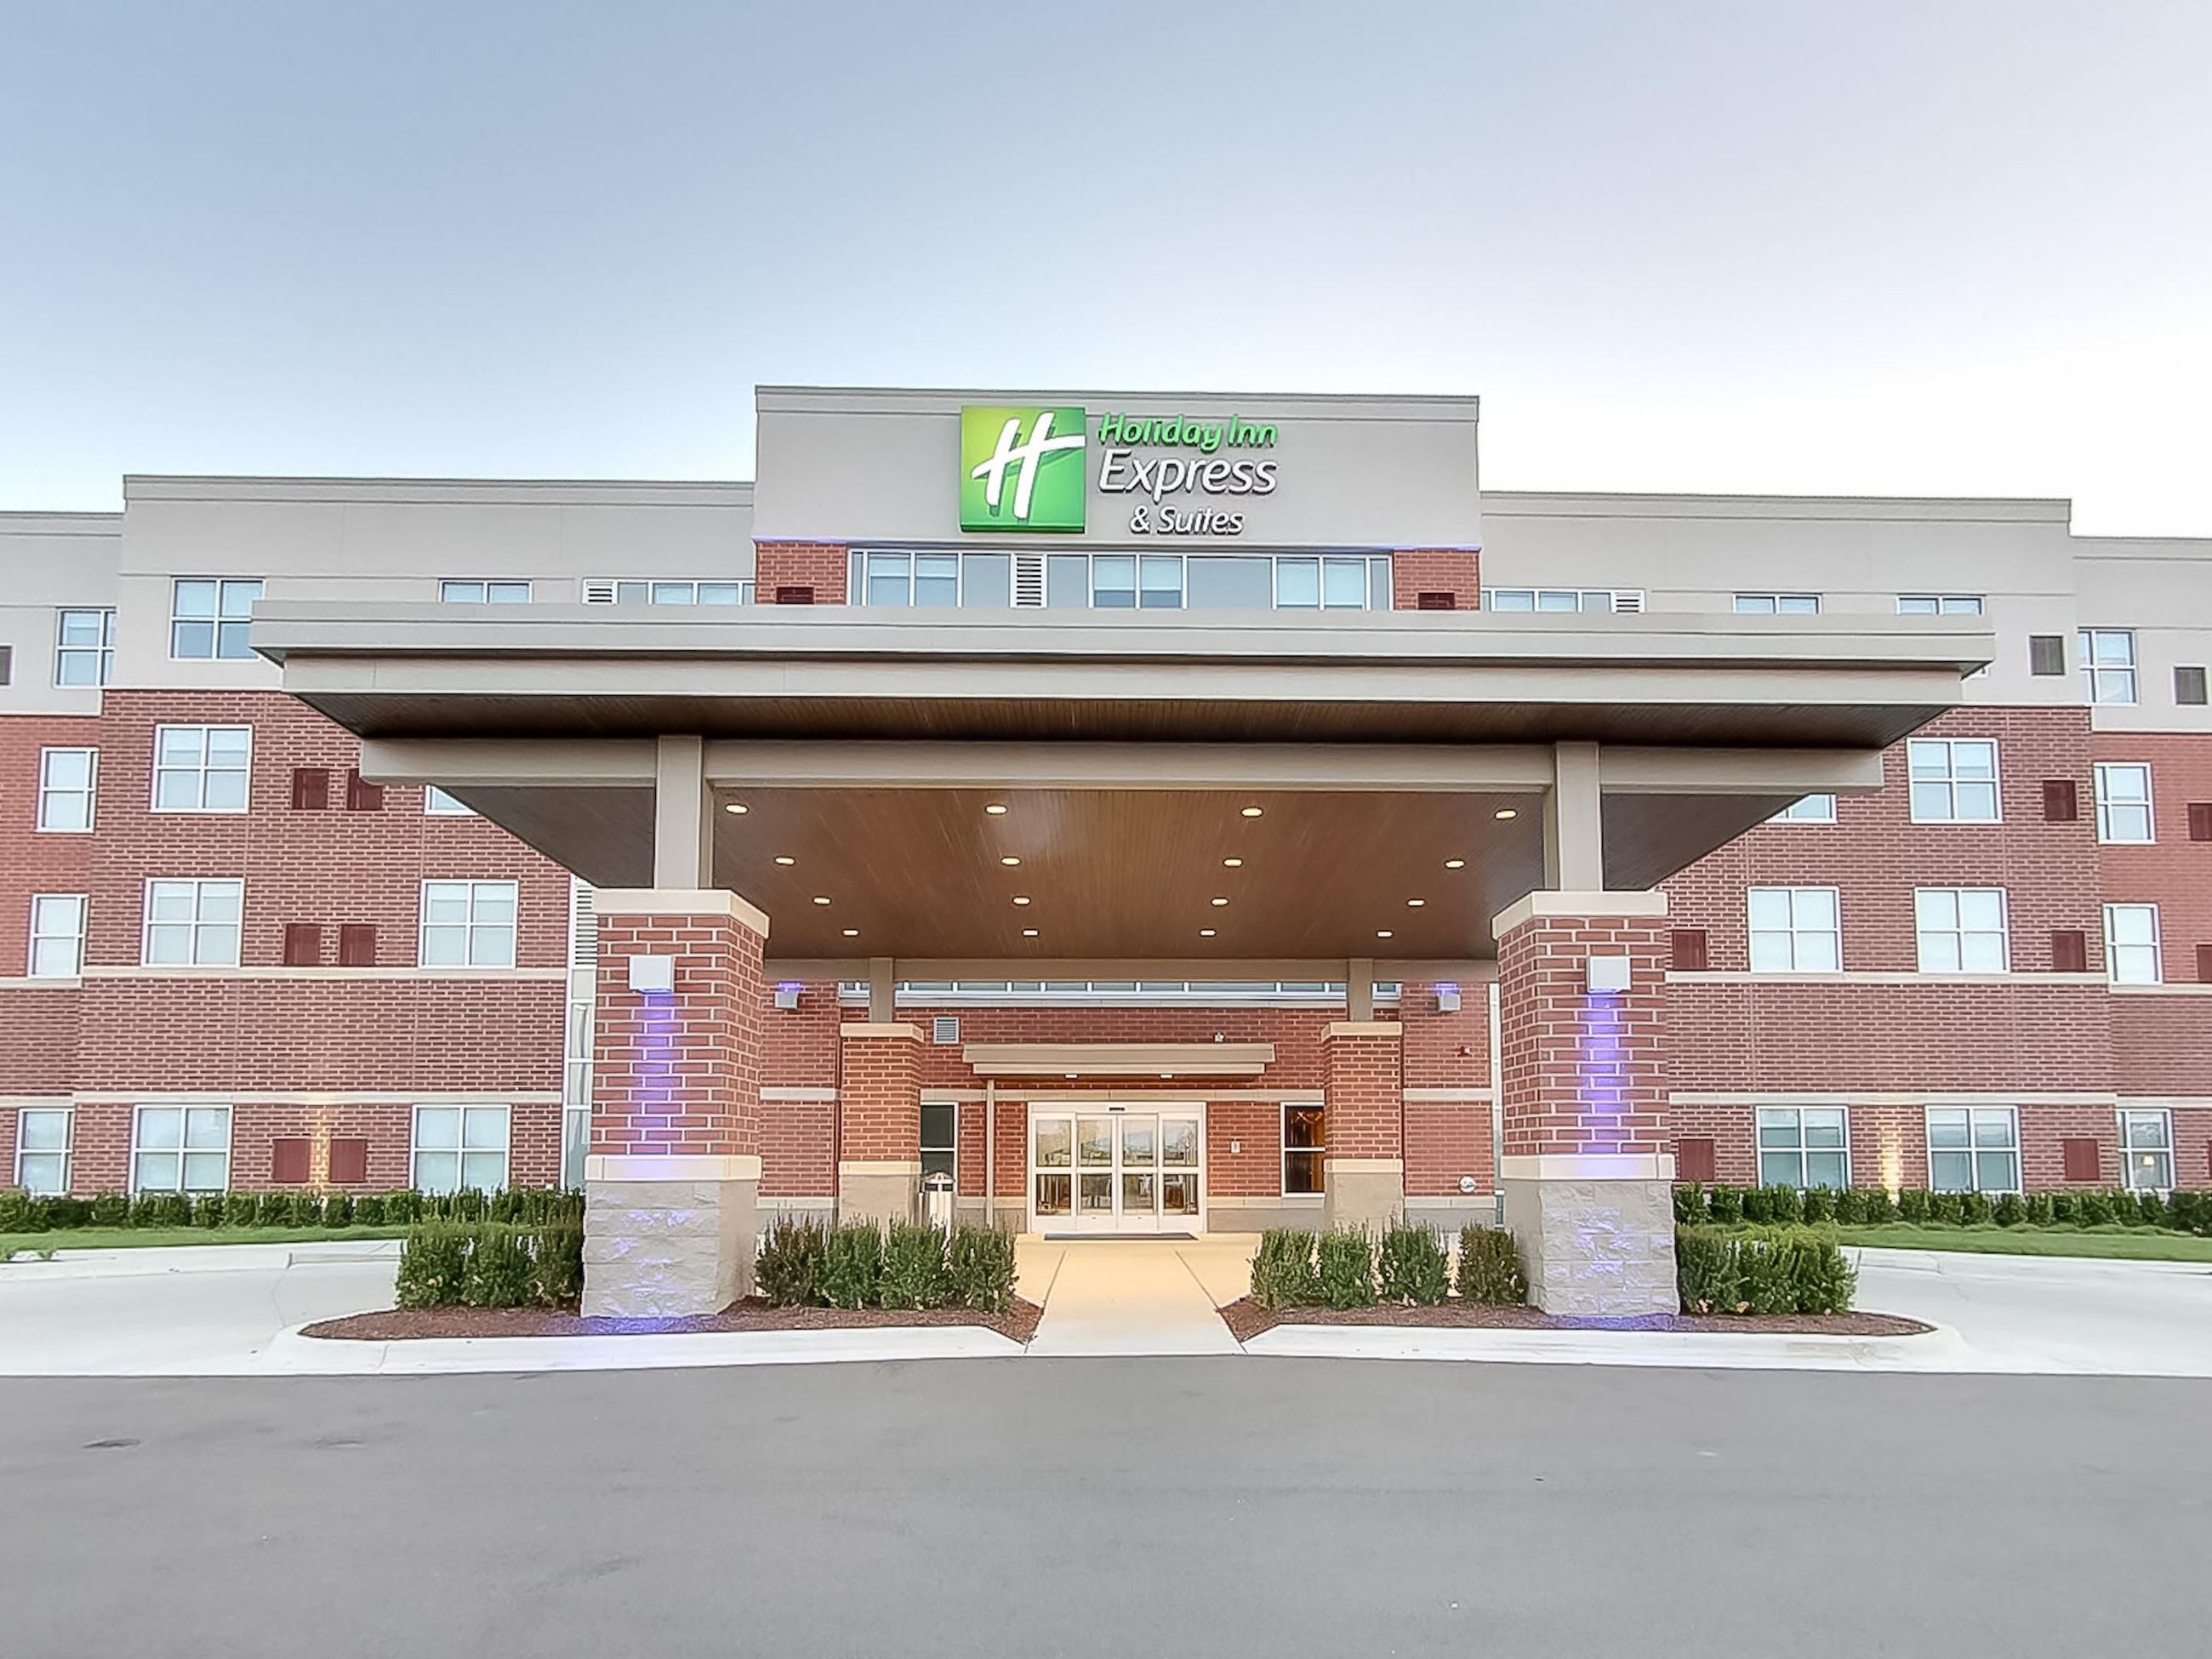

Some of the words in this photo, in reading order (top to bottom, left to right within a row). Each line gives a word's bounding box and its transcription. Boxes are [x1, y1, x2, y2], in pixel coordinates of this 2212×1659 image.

[1098, 412, 1222, 453] Holiday
[1228, 413, 1277, 446] Inn
[1099, 448, 1277, 503] Express
[1131, 505, 1149, 533] &
[1157, 506, 1245, 534] Suites
